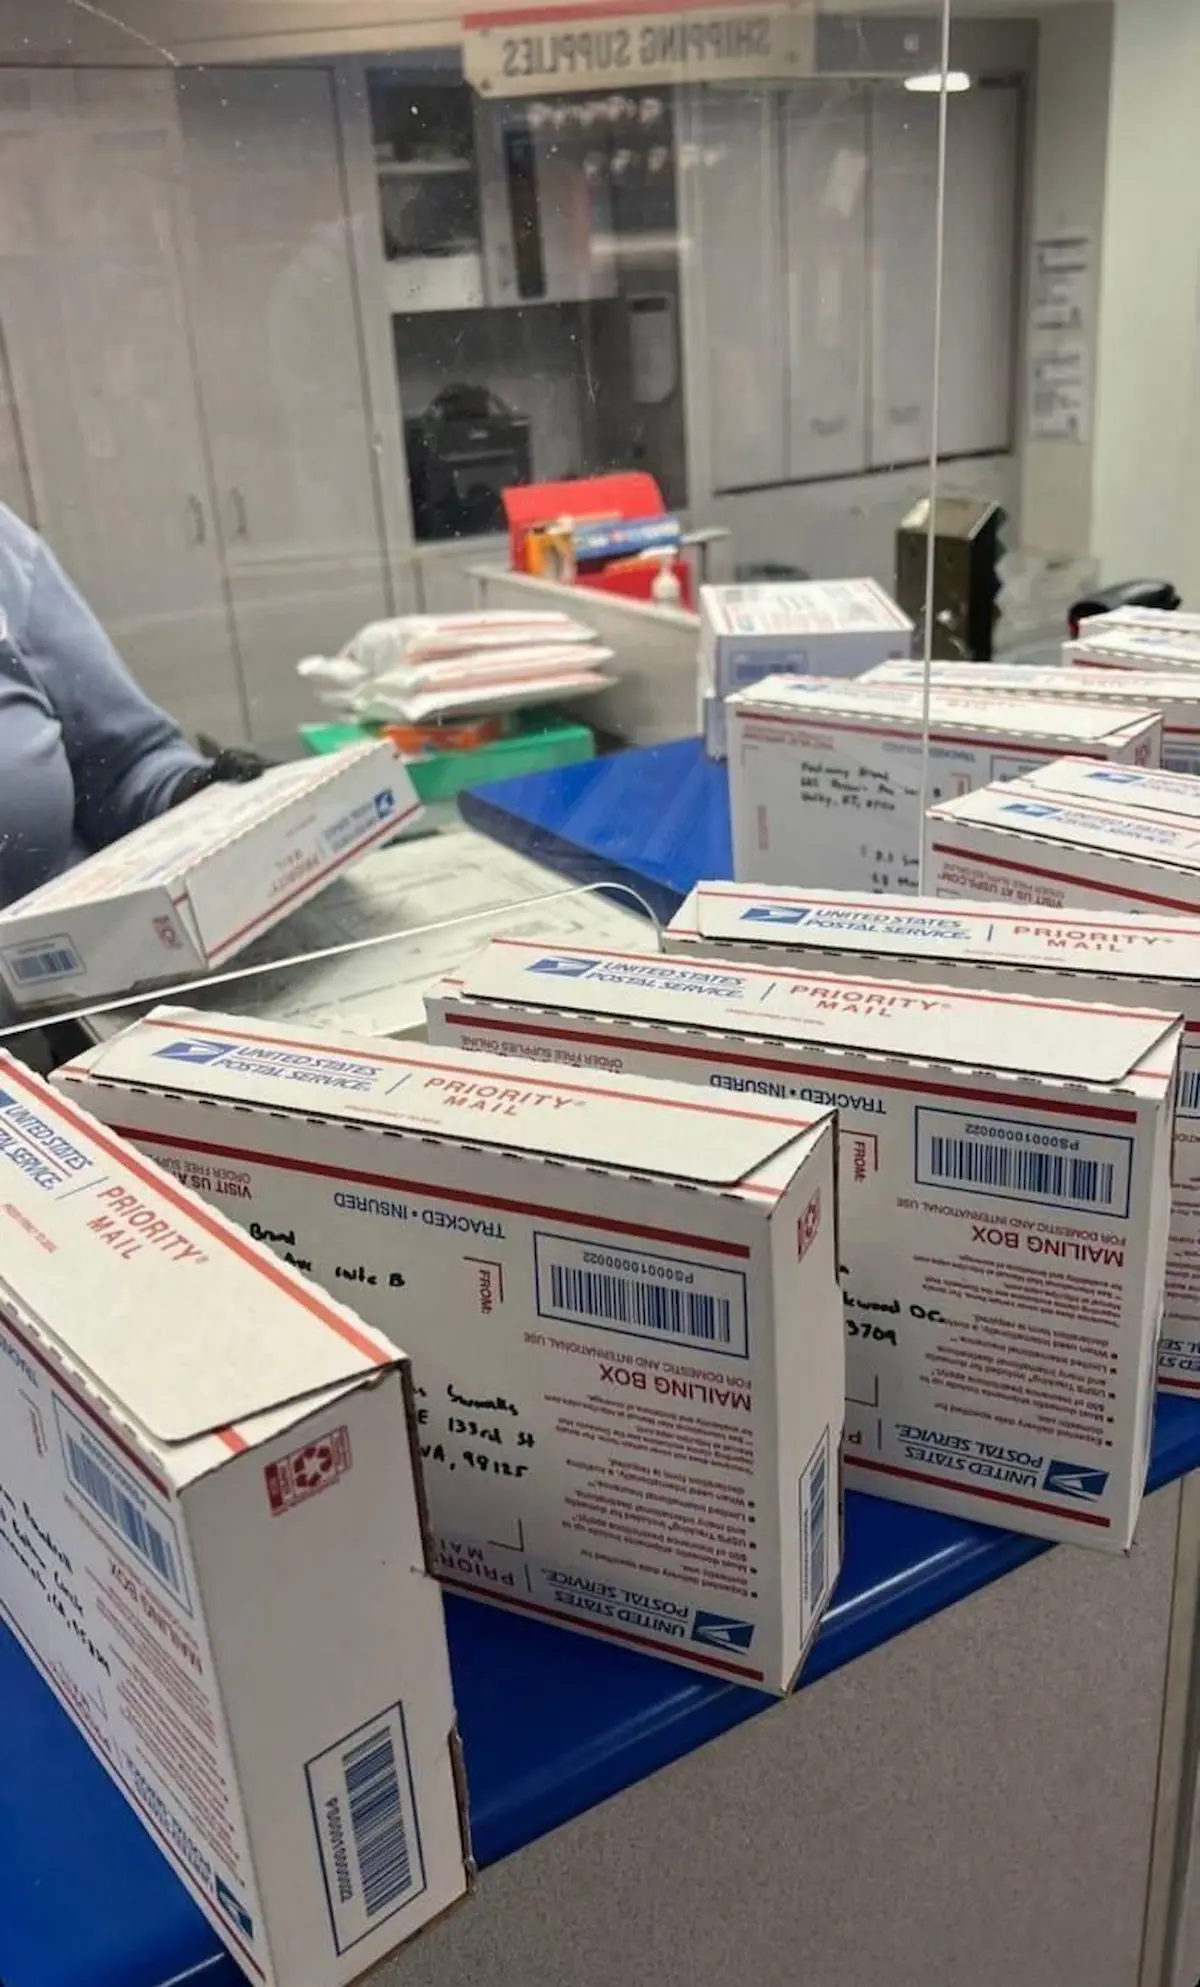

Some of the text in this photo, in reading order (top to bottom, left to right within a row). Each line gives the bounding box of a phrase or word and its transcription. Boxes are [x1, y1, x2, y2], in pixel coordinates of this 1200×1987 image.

[804, 919, 876, 933] POSTAL
[816, 909, 964, 928] UNITED STATES
[1012, 926, 1161, 945] PRIORITY
[1047, 939, 1123, 953] MAIL
[592, 972, 657, 990] POSTAL
[603, 961, 747, 986] UNITED STATES
[789, 984, 941, 1010] PRIORITY
[815, 1000, 892, 1018] MAIL
[213, 1058, 284, 1079] POSTAL
[237, 1046, 384, 1077] UNITED STATES
[423, 1077, 574, 1109] PRIORITY
[443, 1095, 519, 1117] MAIL
[709, 1074, 887, 1115] TRACKED INSURED
[5, 1105, 90, 1170] UNITED STATES
[191, 1176, 212, 1189] US
[216, 1180, 252, 1200] VISIT
[97, 1185, 201, 1261] PRIORITY
[334, 1192, 506, 1239] TRACKED INSURED
[87, 1215, 144, 1261] MAIL
[972, 1225, 1124, 1267] MAILING BOX
[846, 1319, 897, 1347] 3709
[599, 1363, 750, 1411] MAILING BOX
[417, 1409, 429, 1425] E
[463, 1451, 529, 1478] 98125
[904, 1446, 1037, 1488] UNITED STATES
[978, 1443, 1045, 1468] POSTAL
[440, 1539, 484, 1561] MAI
[435, 1552, 515, 1586] PRIOR
[554, 1590, 686, 1638] UNITED STATES
[620, 1588, 689, 1619] POSTAL
